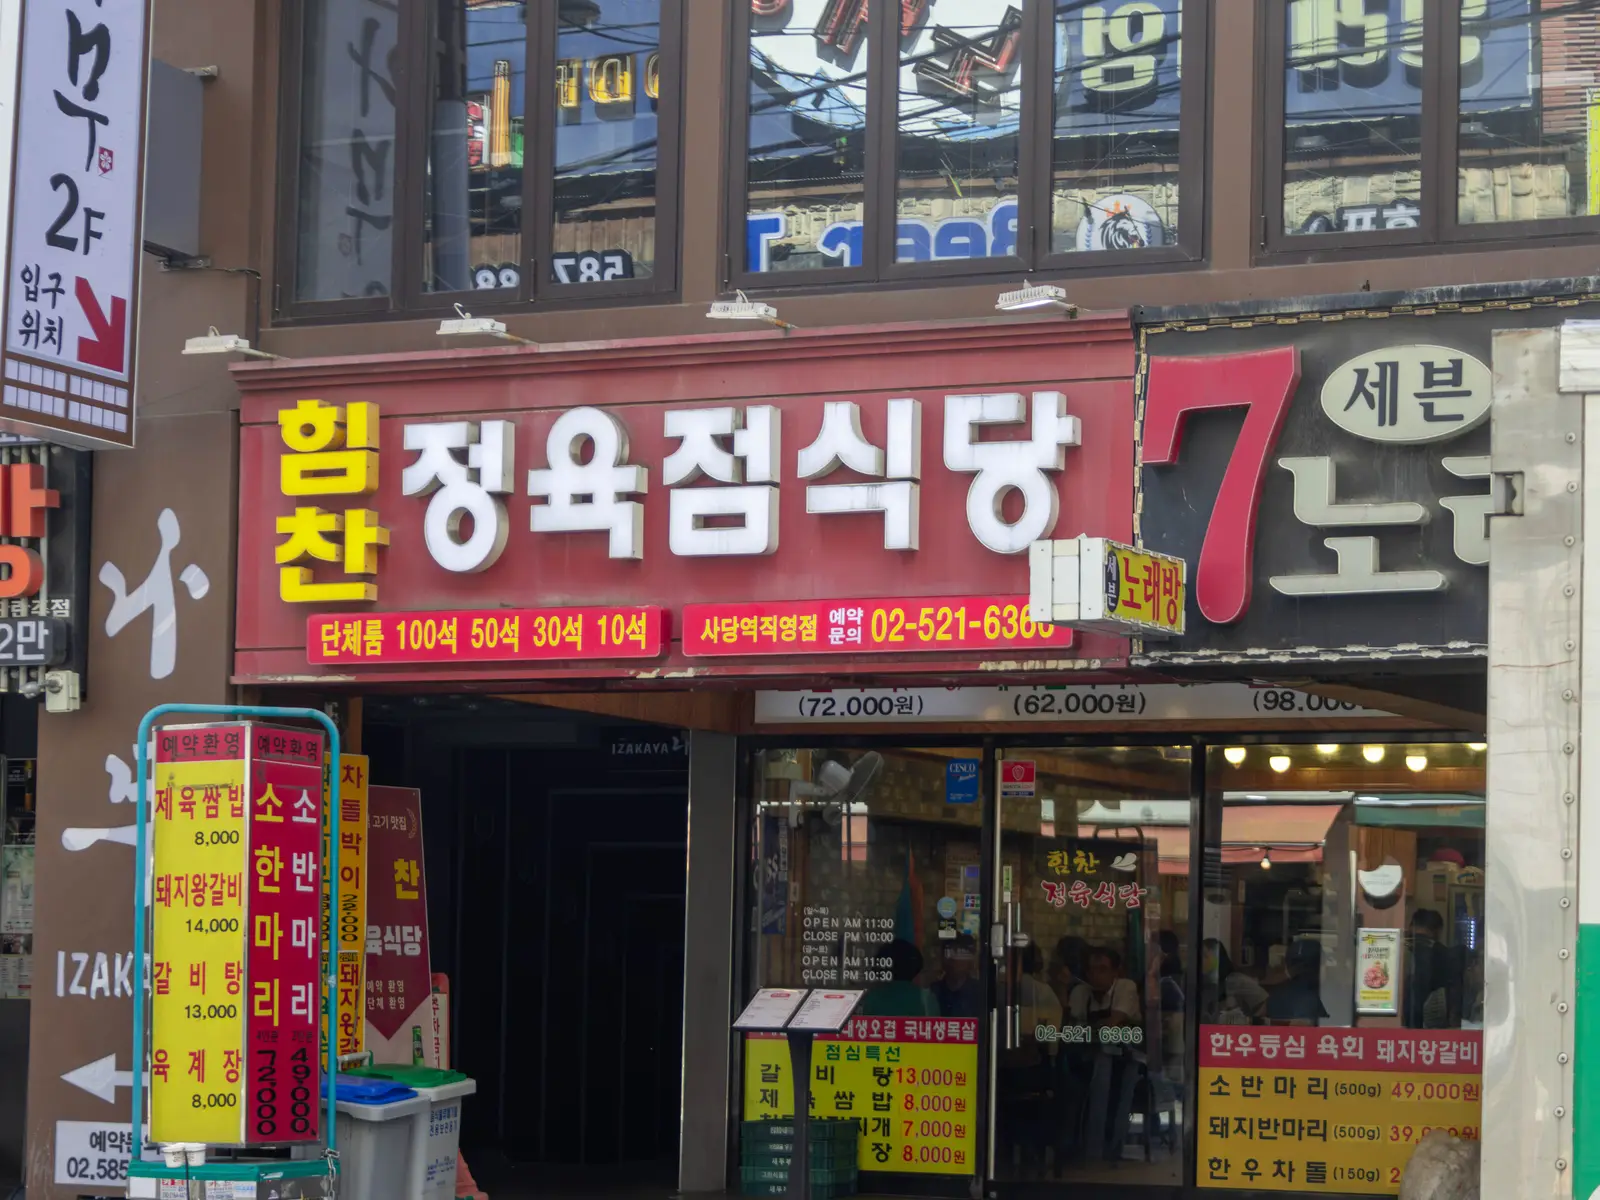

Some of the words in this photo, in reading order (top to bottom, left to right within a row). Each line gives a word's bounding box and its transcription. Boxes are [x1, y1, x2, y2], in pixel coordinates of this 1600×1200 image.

[46, 173, 105, 255] 2F
[20, 264, 65, 309] 입구
[19, 310, 63, 355] 위치
[1344, 359, 1472, 427] 세븐
[402, 391, 1082, 573] 정육점식당
[1142, 345, 1300, 624] 7
[275, 399, 390, 603] 힘찬
[1122, 557, 1181, 625] 노래방
[700, 612, 817, 644] 사당역직영점
[829, 607, 863, 626] 예약
[321, 619, 384, 656] 단체룸
[396, 617, 457, 654] 100석
[470, 615, 519, 653] 50석
[532, 613, 583, 651] 30석
[597, 612, 648, 649] 10석
[829, 627, 862, 645] 문의
[162, 732, 240, 759] 예약환영
[257, 735, 317, 762] 예약환영
[611, 743, 669, 755] IZAKAYA
[155, 784, 245, 821] 제육쌈밥
[194, 831, 239, 847] 8,000
[340, 764, 364, 890] 차돌박이
[1047, 851, 1100, 875] 힘찬
[155, 872, 243, 907] 돼지왕갈비
[1041, 880, 1147, 908] 정육식당
[254, 783, 284, 1026] 소한마리
[291, 789, 317, 1024] 소반마리
[186, 919, 238, 934] 14,000
[803, 918, 839, 928] OPEN
[844, 919, 861, 928] AM
[865, 919, 894, 929] 11:00
[803, 931, 838, 941] CLOSE
[844, 932, 860, 942] PM
[865, 932, 894, 942] 10:00
[802, 956, 838, 966] OPEN
[844, 957, 860, 967] AM
[864, 957, 893, 967] 11:00
[154, 961, 243, 995] 갈비탕
[366, 980, 383, 992] 예약
[388, 980, 404, 992] 환영
[802, 970, 837, 980] CLOSE
[843, 970, 859, 980] PM
[864, 971, 893, 981] 10:30
[185, 1004, 236, 1019] 13,000
[367, 997, 384, 1010] 단체
[388, 997, 405, 1010] 환영
[834, 1019, 896, 1039] 내생오겹
[905, 1020, 976, 1040] 국내생목살
[1034, 1025, 1091, 1043] 02-521
[1100, 1027, 1143, 1044] 6366
[826, 1045, 900, 1062] 점심특선
[1210, 1032, 1305, 1059] 한우등심
[1317, 1034, 1364, 1060] 육회
[1377, 1039, 1478, 1065] 돼지왕갈비
[153, 1049, 242, 1083] 육계장
[896, 1067, 967, 1087] 13,000원
[192, 1094, 236, 1109] 8,000
[904, 1093, 966, 1113] 8,000원
[1334, 1082, 1381, 1098] (500g)
[1391, 1082, 1479, 1101] 49,000원
[904, 1121, 966, 1139] 7,000원
[1209, 1116, 1327, 1141] 돼지반마리
[1333, 1125, 1381, 1140] (500g)
[902, 1145, 965, 1164] 8,000원
[1208, 1157, 1327, 1184] 한우차돌
[1333, 1167, 1380, 1182] (150g)
